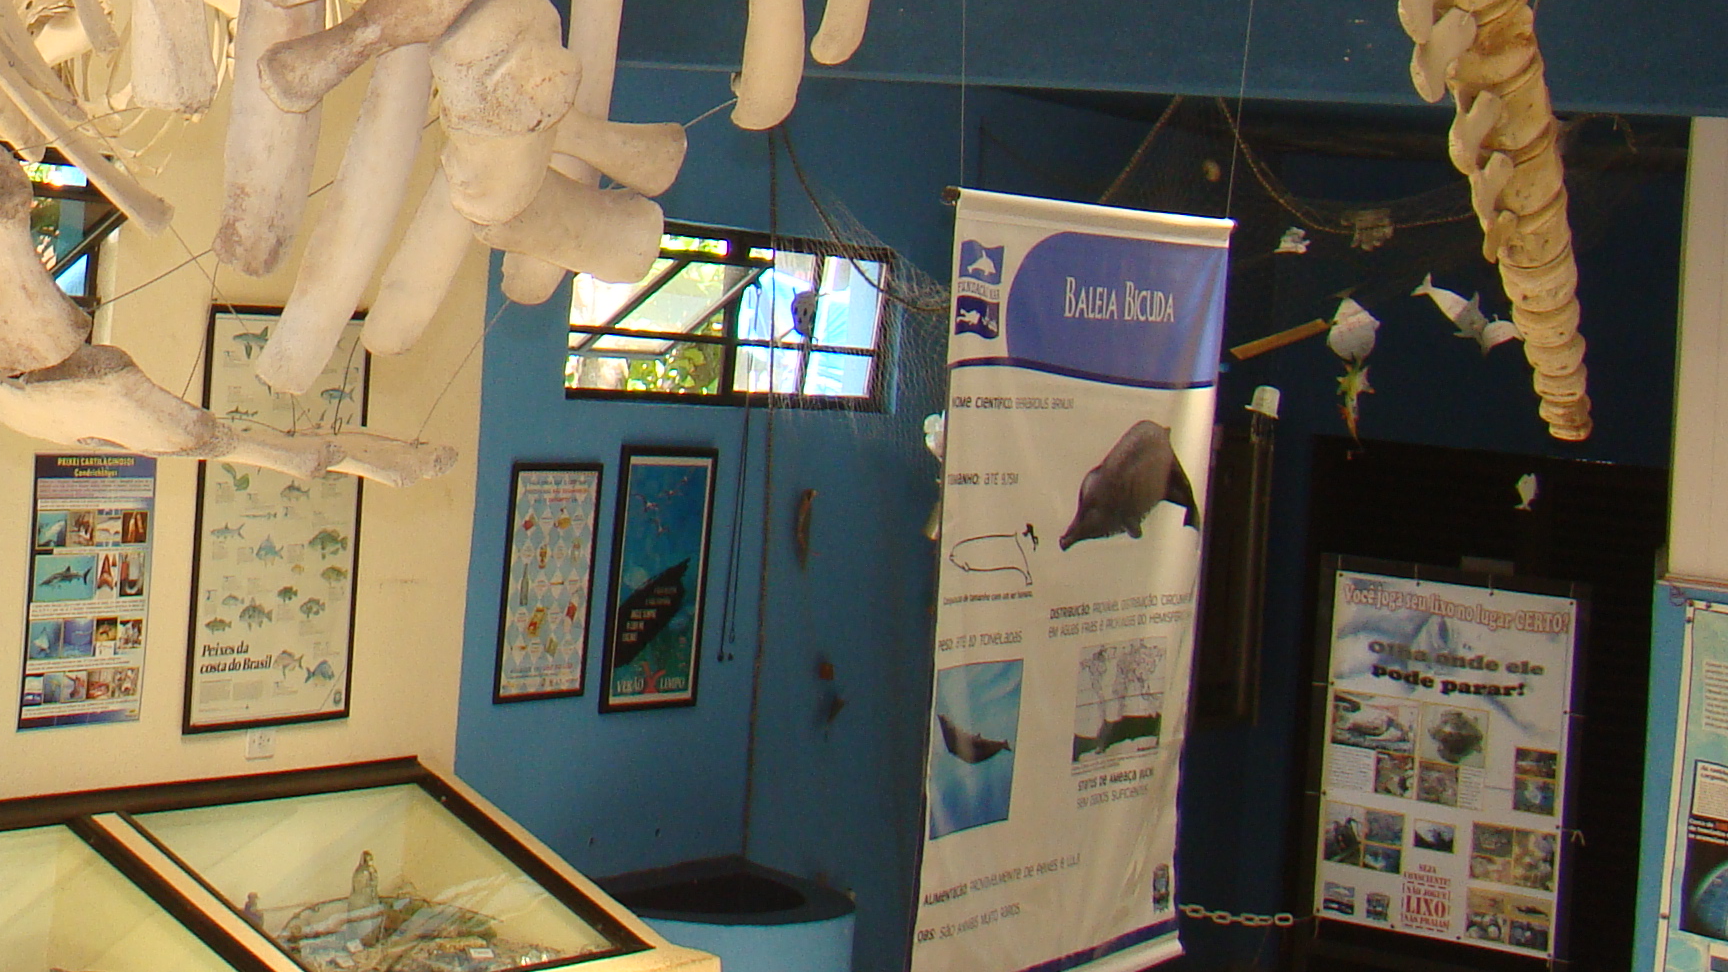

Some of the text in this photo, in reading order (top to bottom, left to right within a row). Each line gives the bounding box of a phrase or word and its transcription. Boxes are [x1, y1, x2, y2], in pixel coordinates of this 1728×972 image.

[1344, 584, 1374, 605] Você
[1376, 587, 1403, 611] joga
[1405, 593, 1427, 611] seu
[1429, 593, 1456, 616] lixo
[1457, 604, 1474, 622] no
[1475, 603, 1513, 632] lugar
[201, 640, 249, 657] Peixes da
[200, 654, 272, 674] costa do Brasil
[1434, 651, 1500, 672] onde
[1505, 659, 1545, 676] ele
[1371, 663, 1526, 696] pode parar!
[1405, 895, 1447, 919] LIXO
